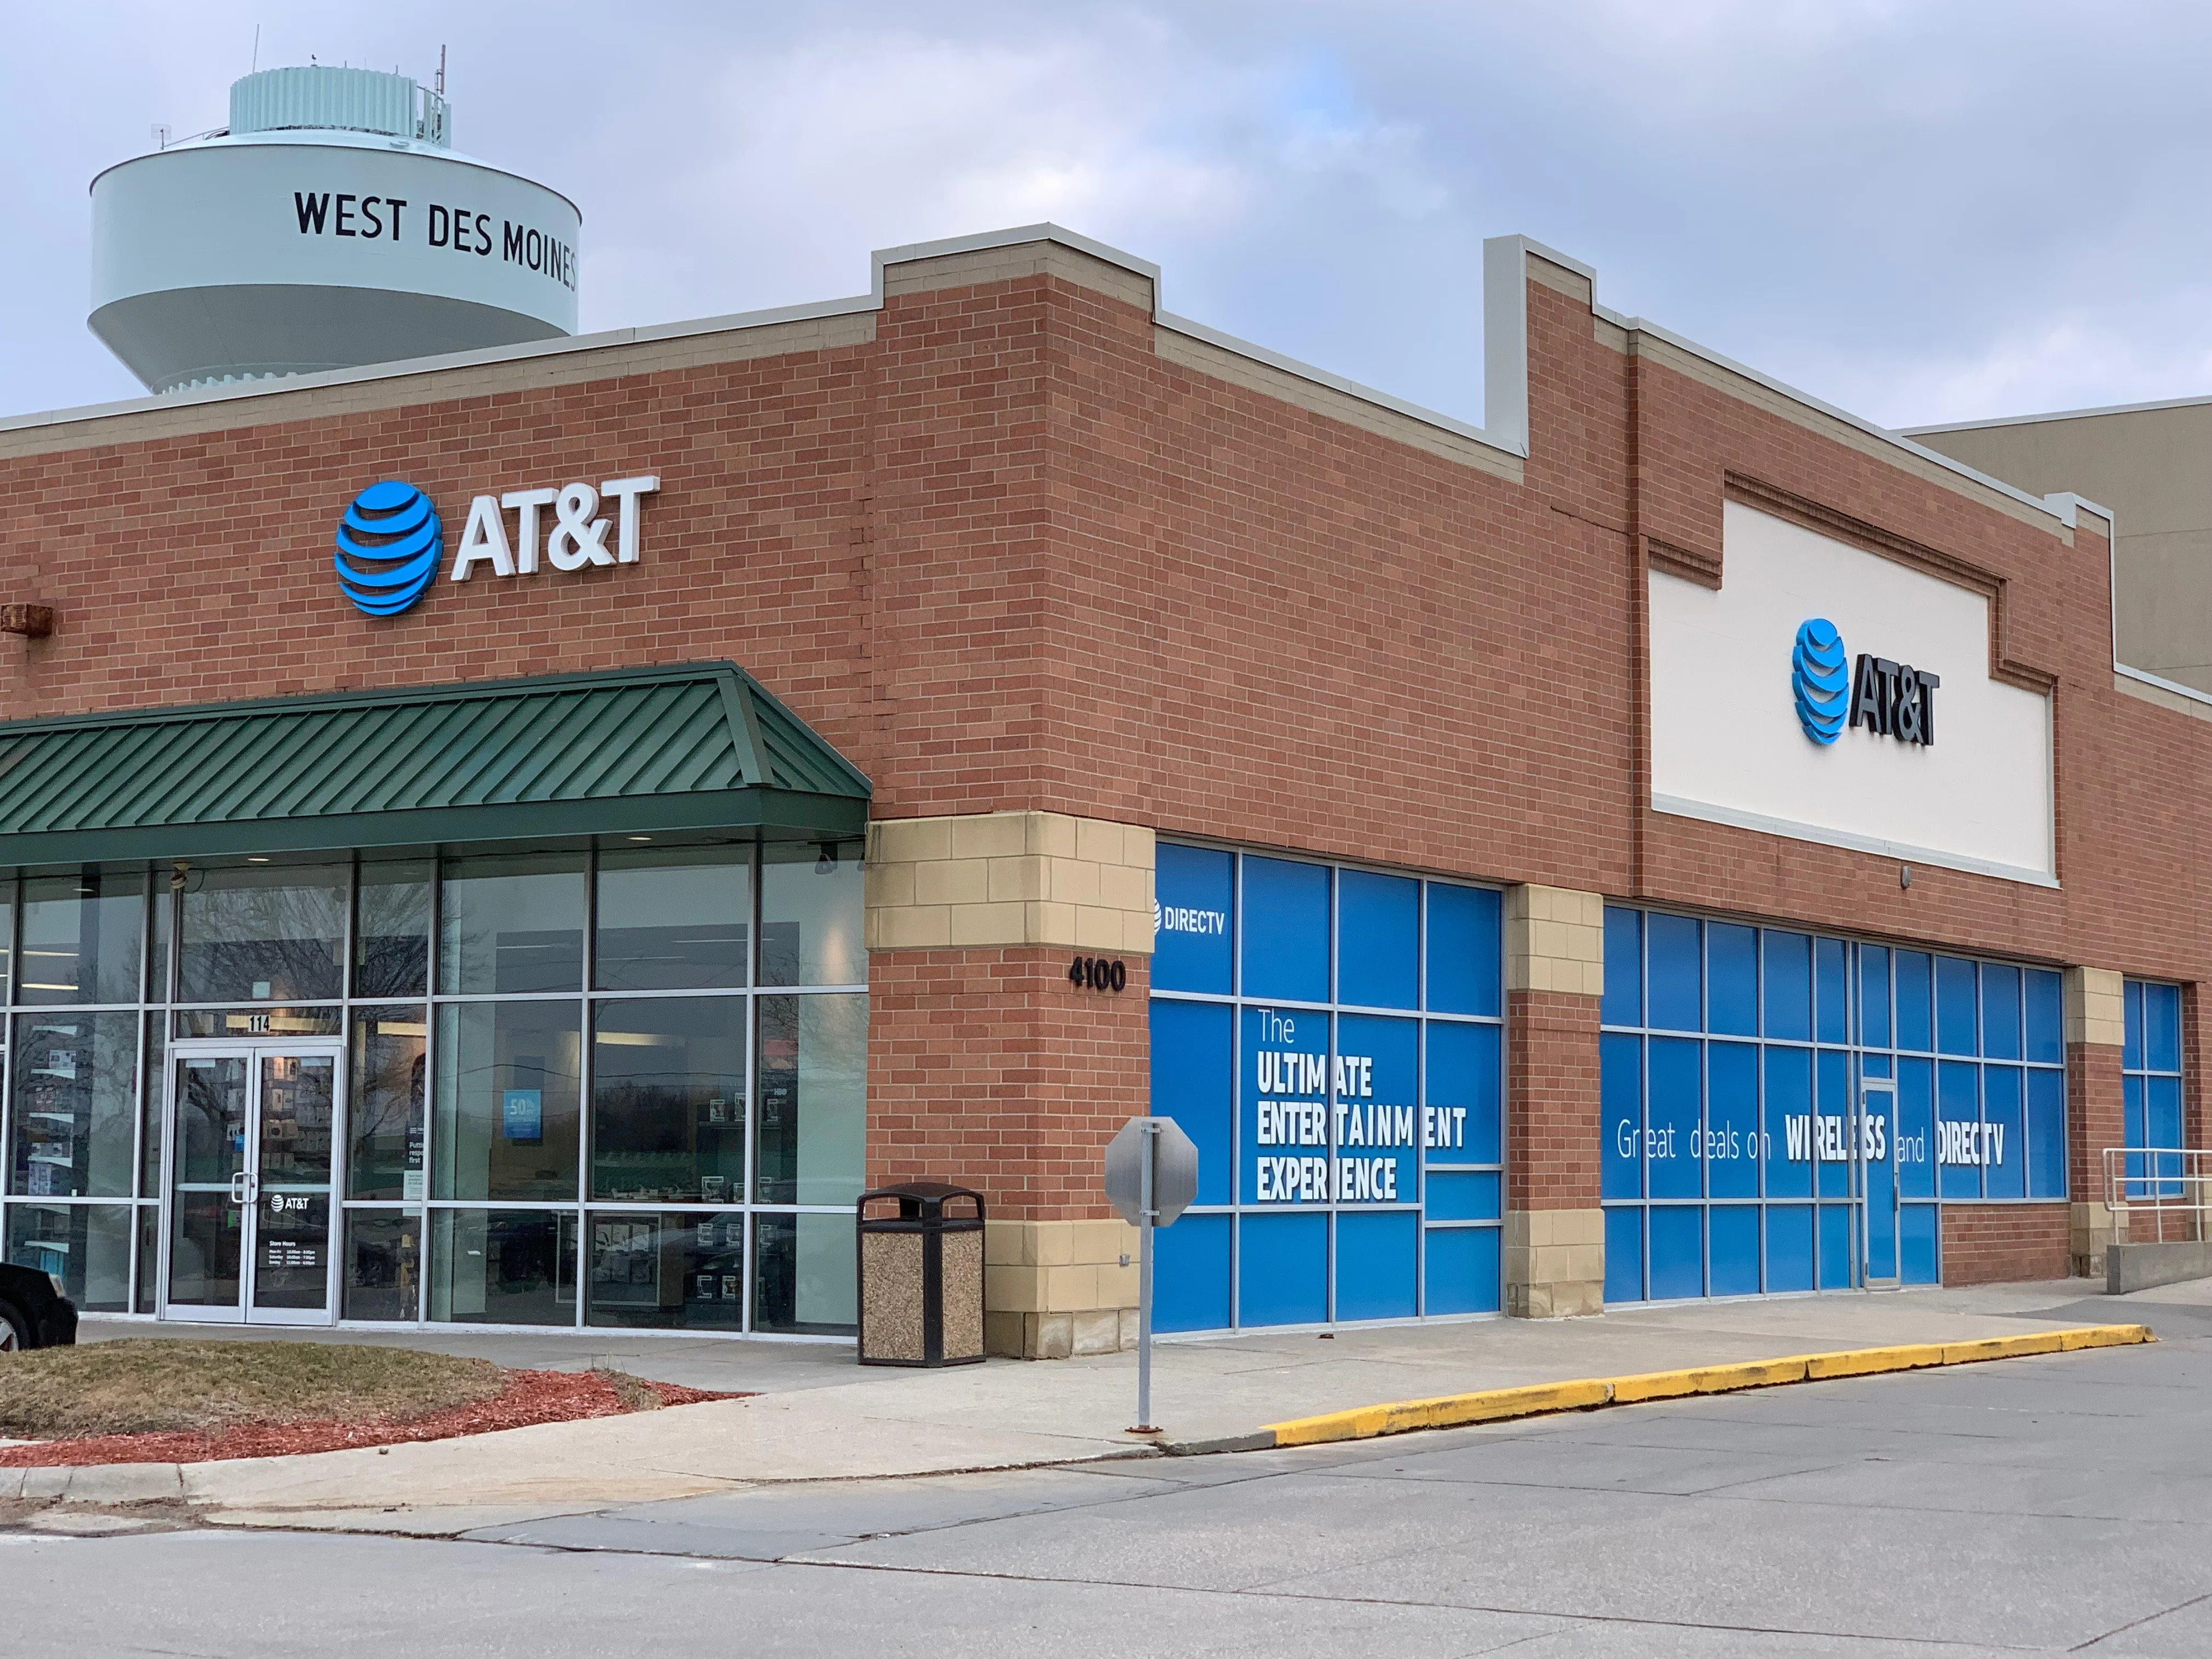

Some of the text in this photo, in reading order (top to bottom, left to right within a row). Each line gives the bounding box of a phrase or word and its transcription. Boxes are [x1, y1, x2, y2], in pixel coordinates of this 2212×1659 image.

[294, 192, 576, 292] WEST DES MOINES
[450, 475, 661, 582] AT&T
[1849, 653, 1940, 746] AT&T
[1165, 906, 1225, 935] DIRECTV
[1070, 956, 1126, 992] 4100
[250, 1015, 269, 1031] 114
[1257, 1008, 1295, 1043] The
[1257, 1051, 1373, 1097] ULTIMATE
[1257, 1101, 1466, 1147] ENTERTAINMENT
[1617, 1119, 1676, 1159] Great
[1690, 1118, 1739, 1159] deals
[1747, 1131, 1771, 1160] on
[1898, 1126, 1925, 1163] and
[1938, 1121, 2004, 1165] DIRECTV
[1257, 1156, 1397, 1200] EXPERIENCE
[285, 1198, 309, 1210] AT&T
